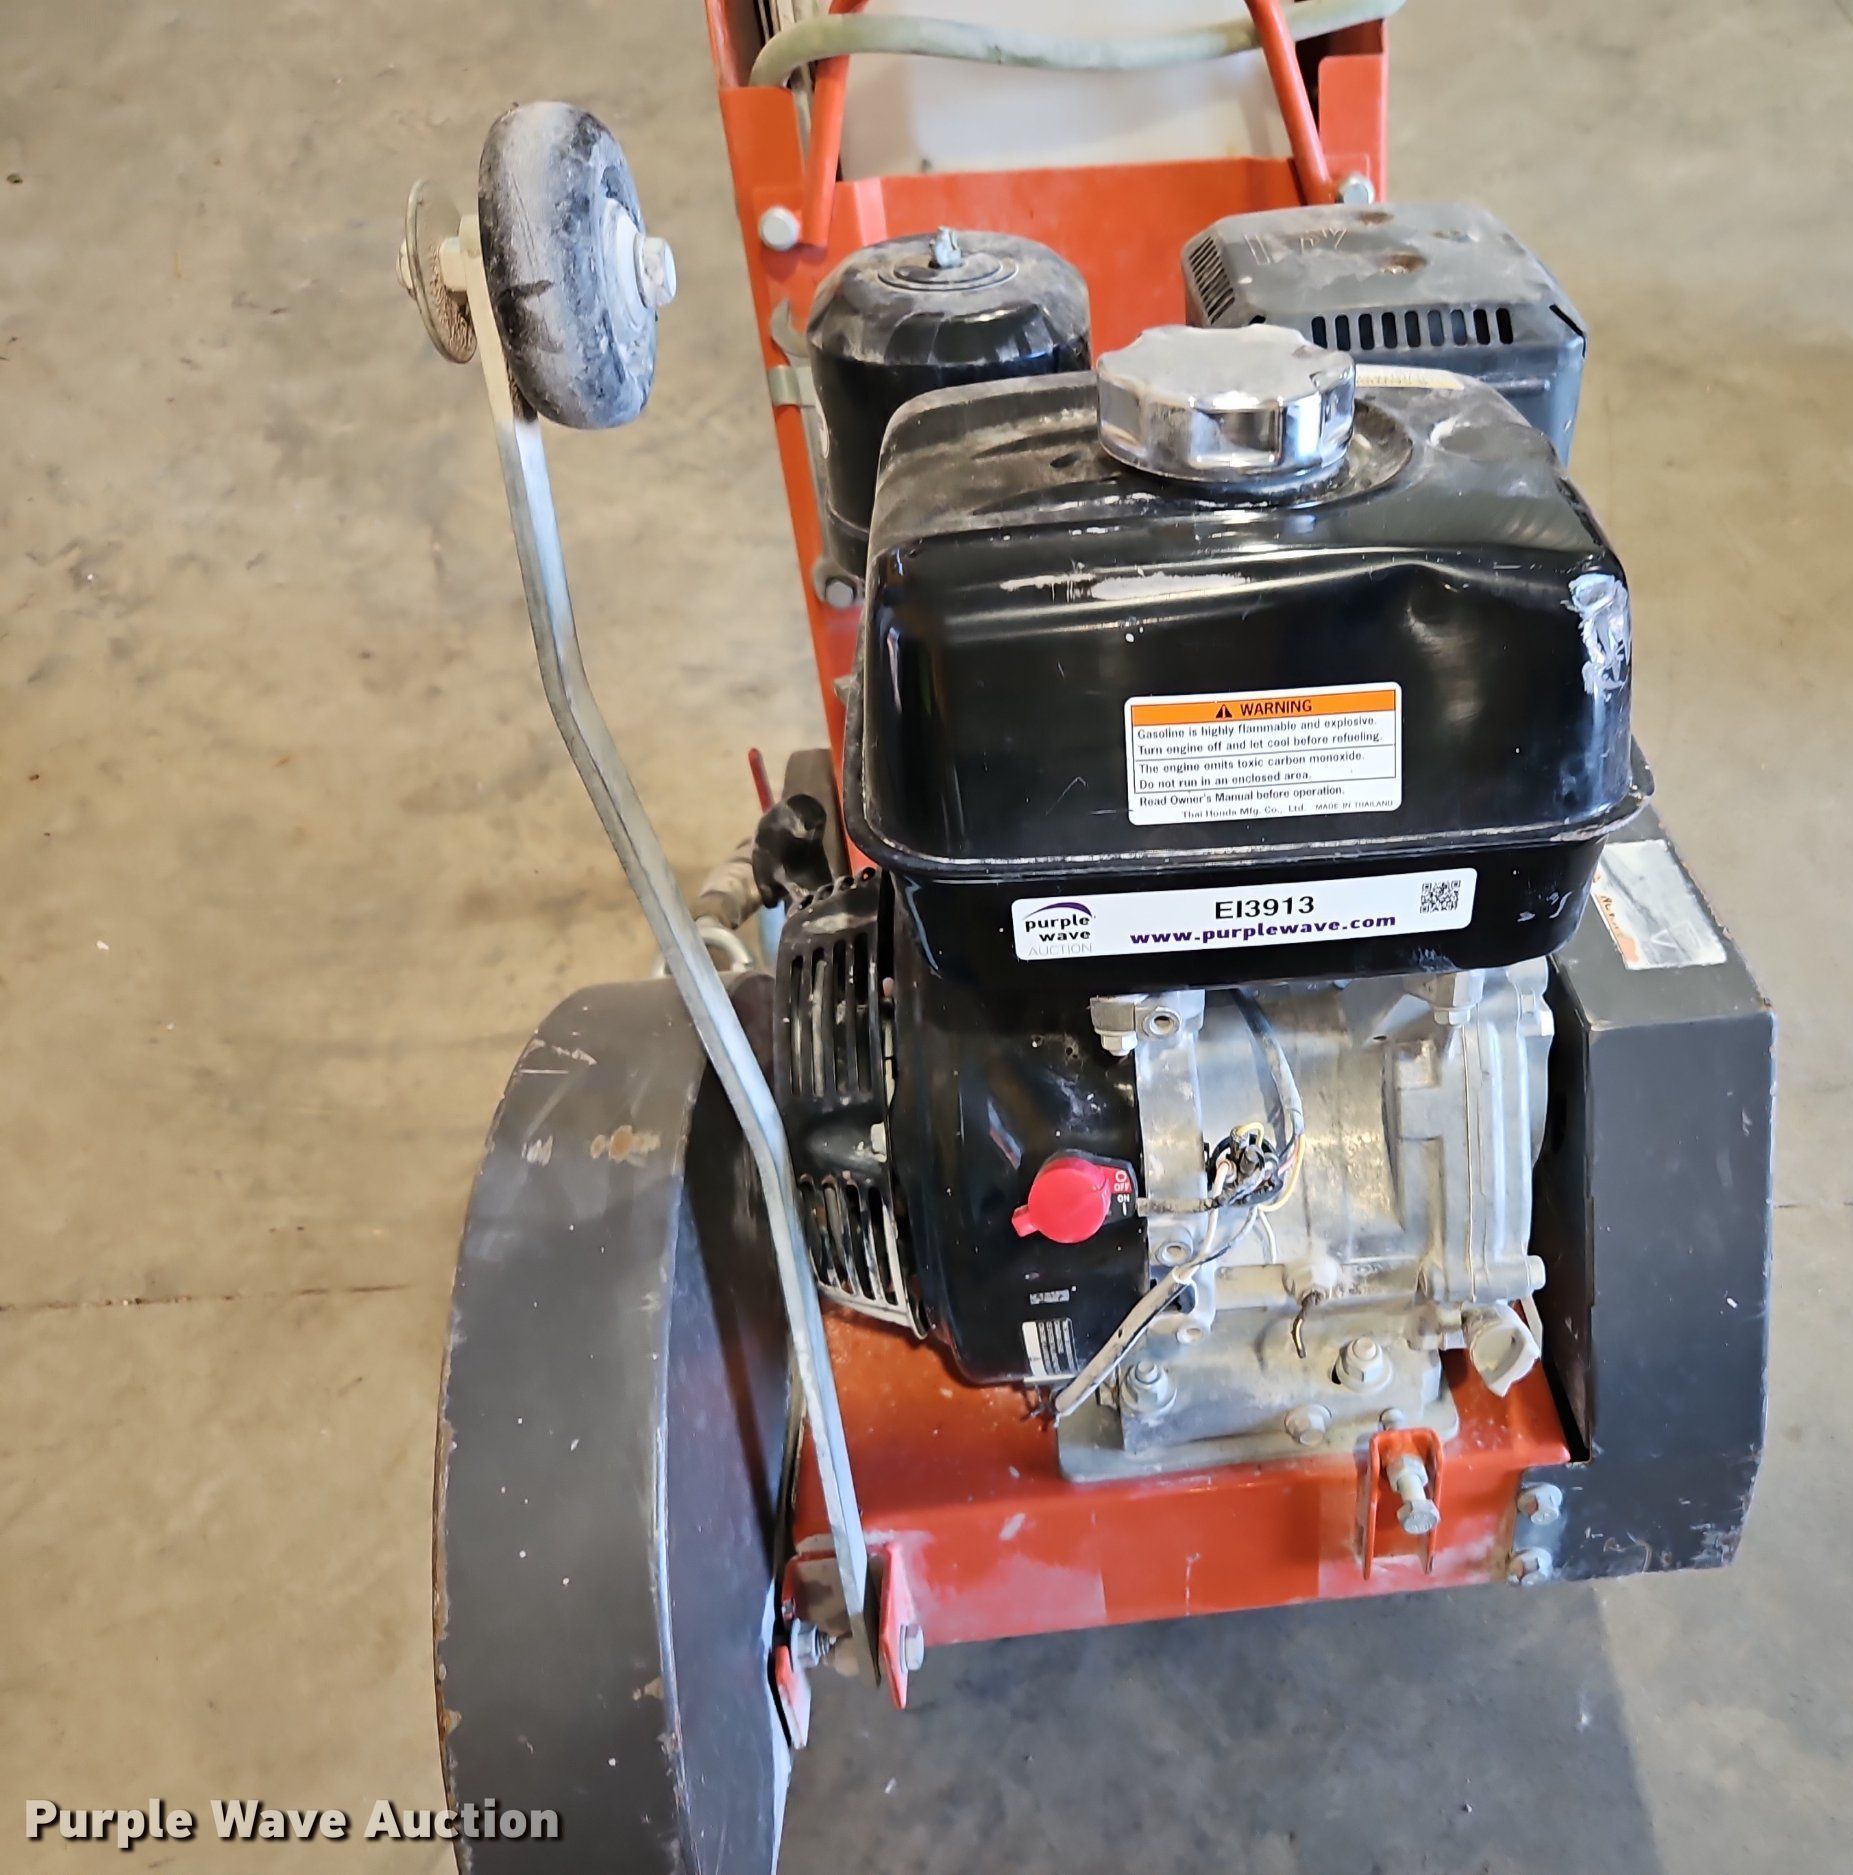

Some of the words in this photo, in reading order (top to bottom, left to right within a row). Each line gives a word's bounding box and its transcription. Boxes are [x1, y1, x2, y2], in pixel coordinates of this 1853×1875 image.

[1240, 699, 1312, 716] WARNING
[1137, 727, 1185, 740] Gasoline
[1188, 726, 1198, 737] is
[1201, 724, 1234, 737] highly
[1238, 720, 1297, 734] flammable
[1300, 718, 1320, 730] and
[1324, 716, 1377, 729] explosive.
[1138, 744, 1162, 755] Turn
[1166, 742, 1203, 755] engine
[1207, 741, 1222, 752] off
[1226, 739, 1246, 750] and
[1250, 738, 1263, 749] let
[1267, 737, 1290, 748] cool
[1294, 734, 1328, 746] before
[1332, 731, 1383, 743] refueling.
[1139, 763, 1159, 774] The
[1163, 762, 1200, 774] engine
[1204, 759, 1234, 771] emits
[1238, 758, 1264, 769] toxic
[1267, 755, 1306, 766] carbon
[1309, 751, 1365, 763] monoxide.
[1139, 779, 1154, 790] Do
[1158, 778, 1175, 788] not
[1179, 779, 1197, 788] run
[1201, 775, 1211, 786] in
[1215, 777, 1228, 785] an
[1232, 770, 1281, 784] enclosed
[1284, 772, 1312, 781] area.
[1139, 795, 1167, 807] Read
[1170, 793, 1212, 805] Owner's
[1215, 790, 1253, 802] Manual
[1256, 788, 1290, 801] before
[1293, 785, 1345, 799] operation.
[1182, 809, 1203, 819] Thai
[1205, 808, 1237, 818] Honda
[1239, 807, 1262, 817] Mfg.
[1315, 801, 1339, 811] MADE
[1342, 800, 1351, 809] IN
[1355, 800, 1393, 809] THAILAND
[1215, 896, 1315, 920] EI3913
[1025, 913, 1091, 933] purple
[1130, 916, 1397, 944] www.purplewave.com
[1039, 931, 1091, 942] wave
[1028, 943, 1092, 956] AUCTION
[1113, 1182, 1131, 1192] OFF
[1116, 1193, 1131, 1203] ON
